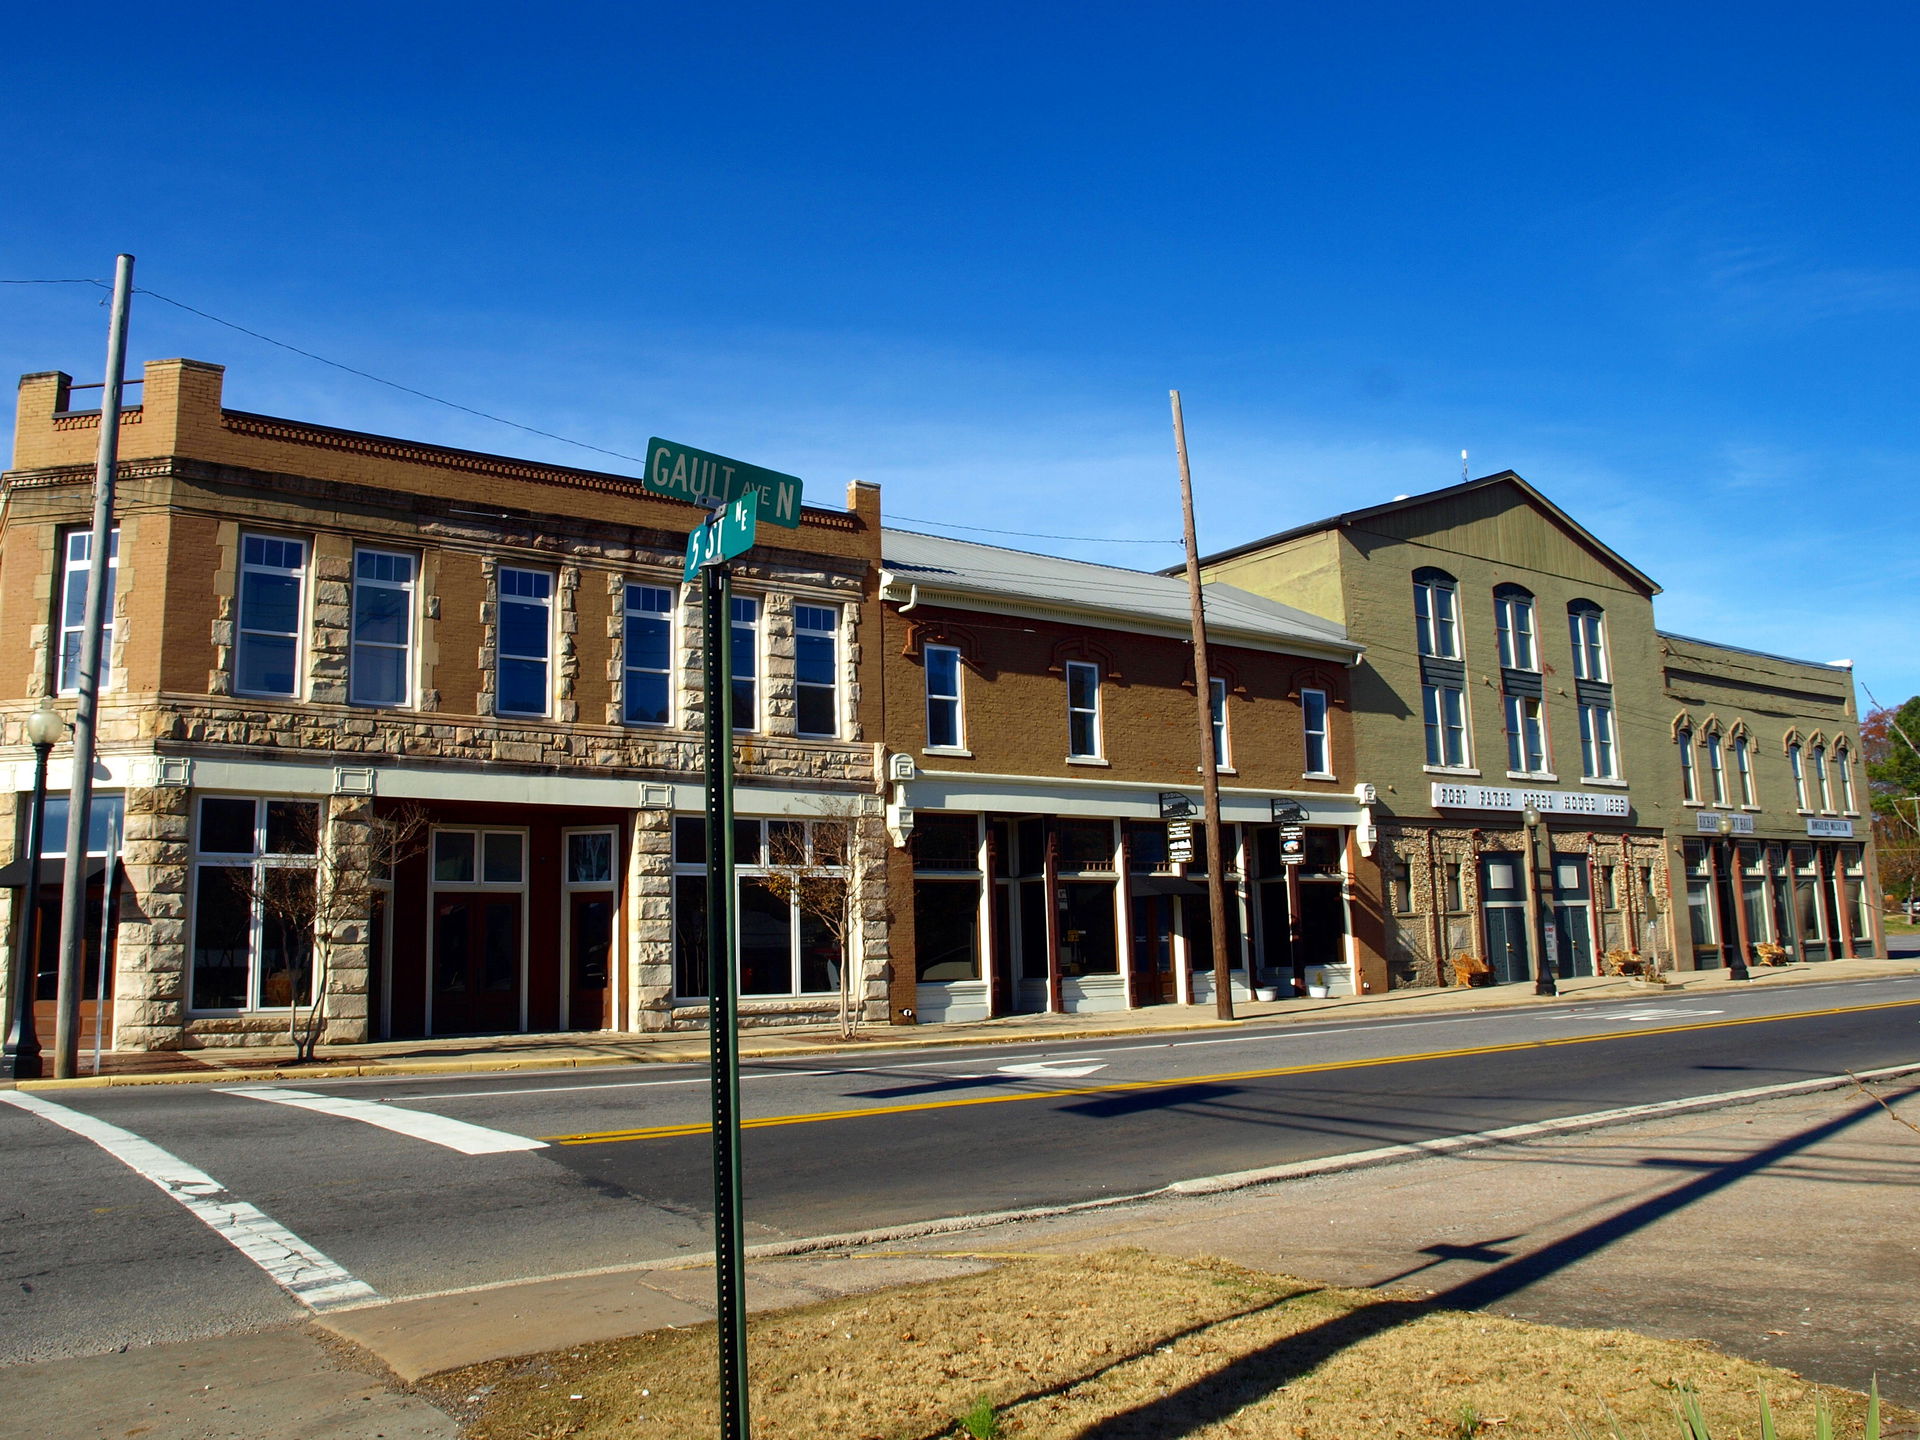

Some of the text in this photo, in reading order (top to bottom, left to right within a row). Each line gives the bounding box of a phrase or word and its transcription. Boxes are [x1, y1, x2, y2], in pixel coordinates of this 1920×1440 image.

[652, 447, 794, 520] GAULT AVE N
[690, 530, 701, 570] 5
[705, 517, 725, 560] ST
[1441, 788, 1467, 804] FORT
[1480, 791, 1511, 806] PAYNE
[1523, 793, 1553, 809] OPERA
[1564, 796, 1595, 811] HOUSE
[1830, 822, 1848, 832] MUSEUM
